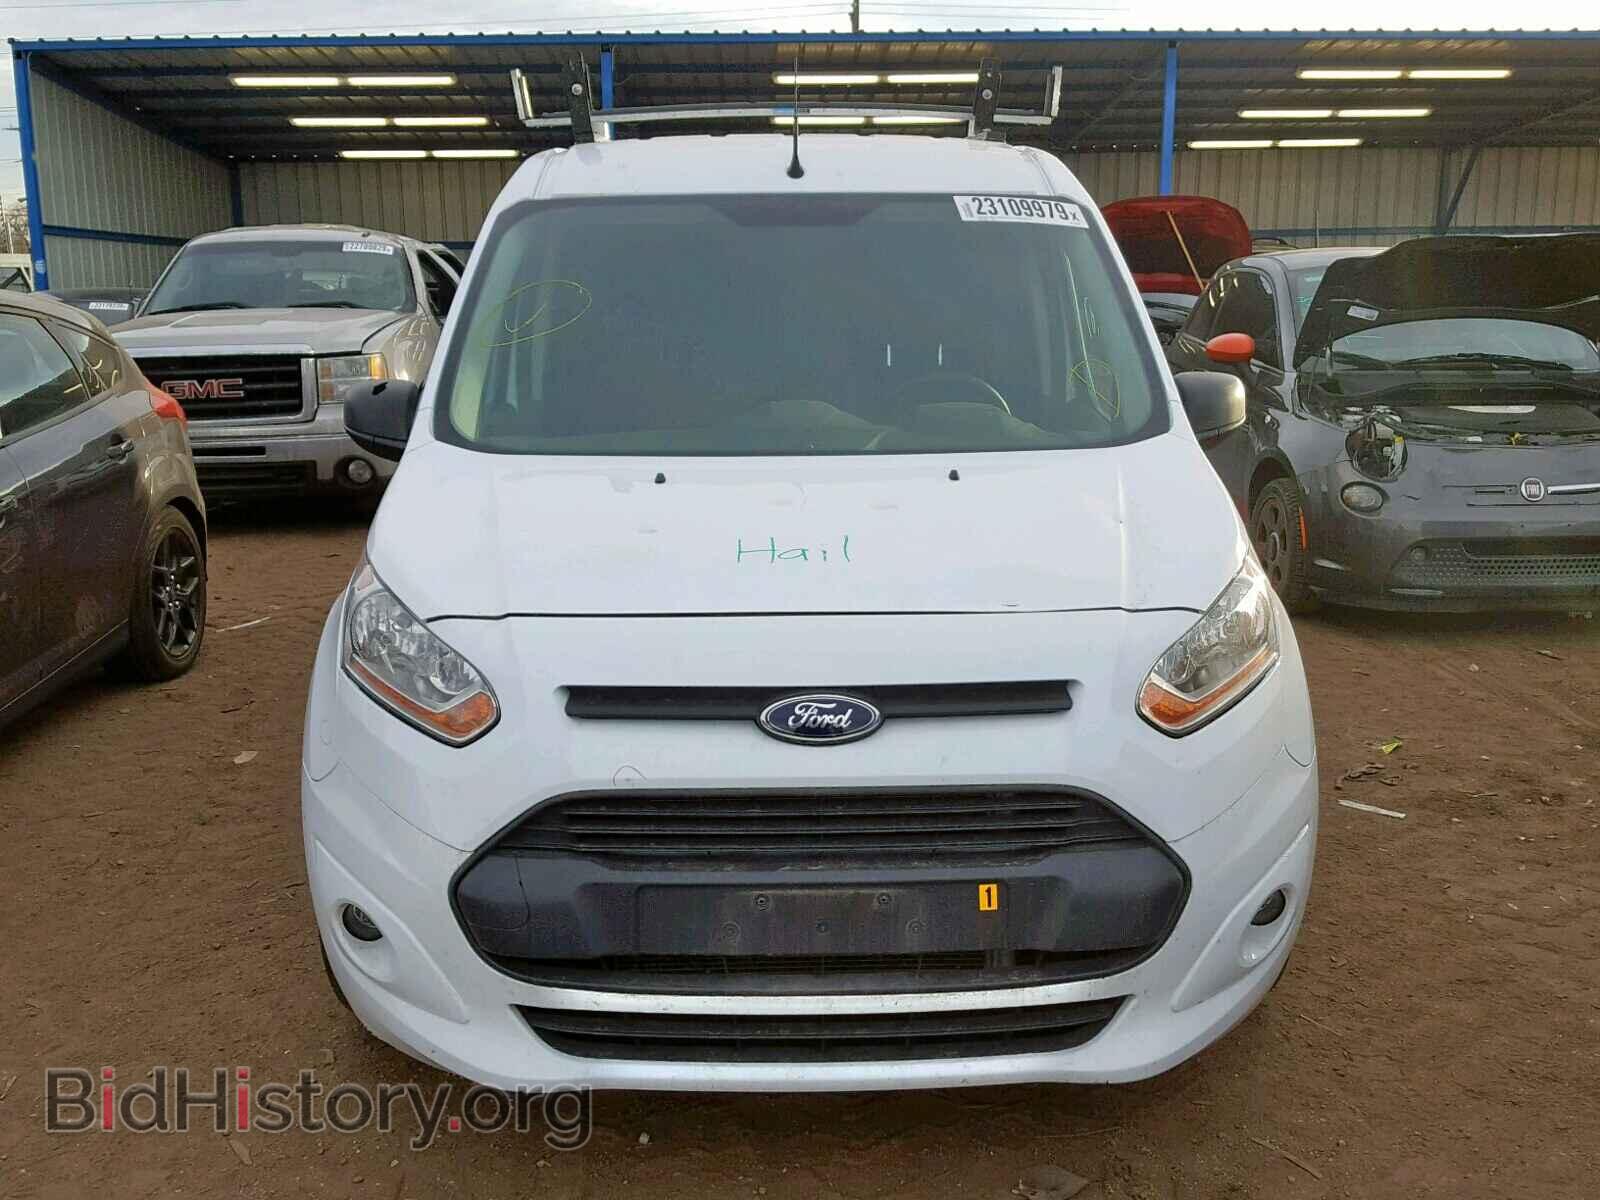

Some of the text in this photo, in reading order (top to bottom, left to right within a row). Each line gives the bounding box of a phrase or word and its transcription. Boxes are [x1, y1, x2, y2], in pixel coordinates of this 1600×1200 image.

[971, 197, 1069, 220] 23109979
[161, 378, 244, 399] GMC
[737, 535, 850, 562] Hail
[787, 702, 853, 728] Ford
[984, 886, 992, 908] 1
